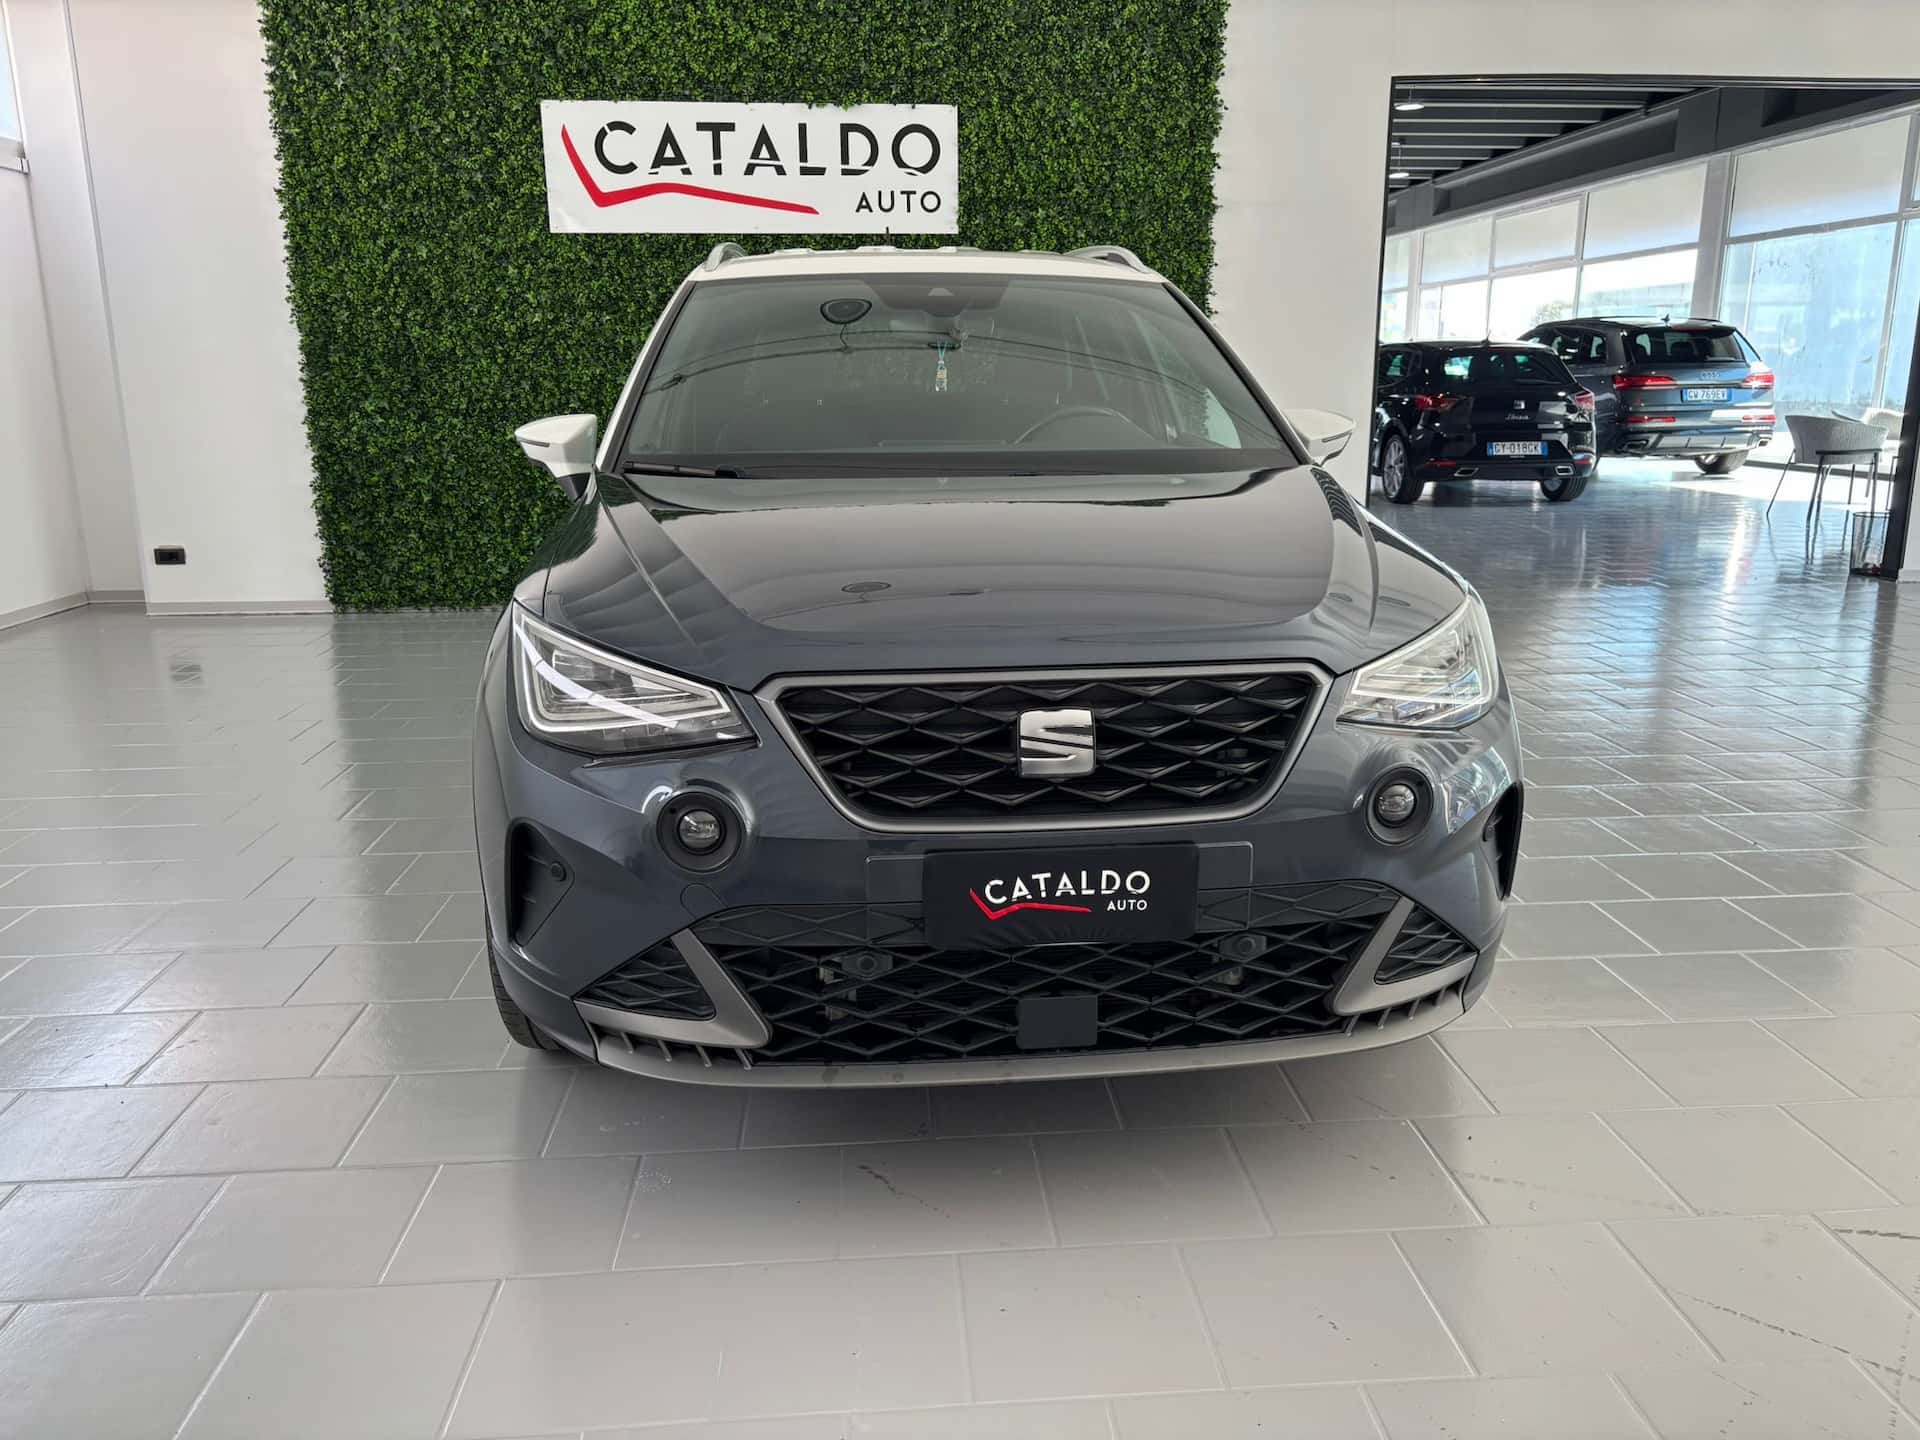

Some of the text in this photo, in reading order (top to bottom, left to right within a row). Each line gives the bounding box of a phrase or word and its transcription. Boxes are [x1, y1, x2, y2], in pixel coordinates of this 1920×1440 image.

[594, 120, 941, 176] CATALDO
[855, 190, 942, 214] AUTO
[984, 869, 1151, 904] CATALDO
[1106, 899, 1148, 912] AUTO
